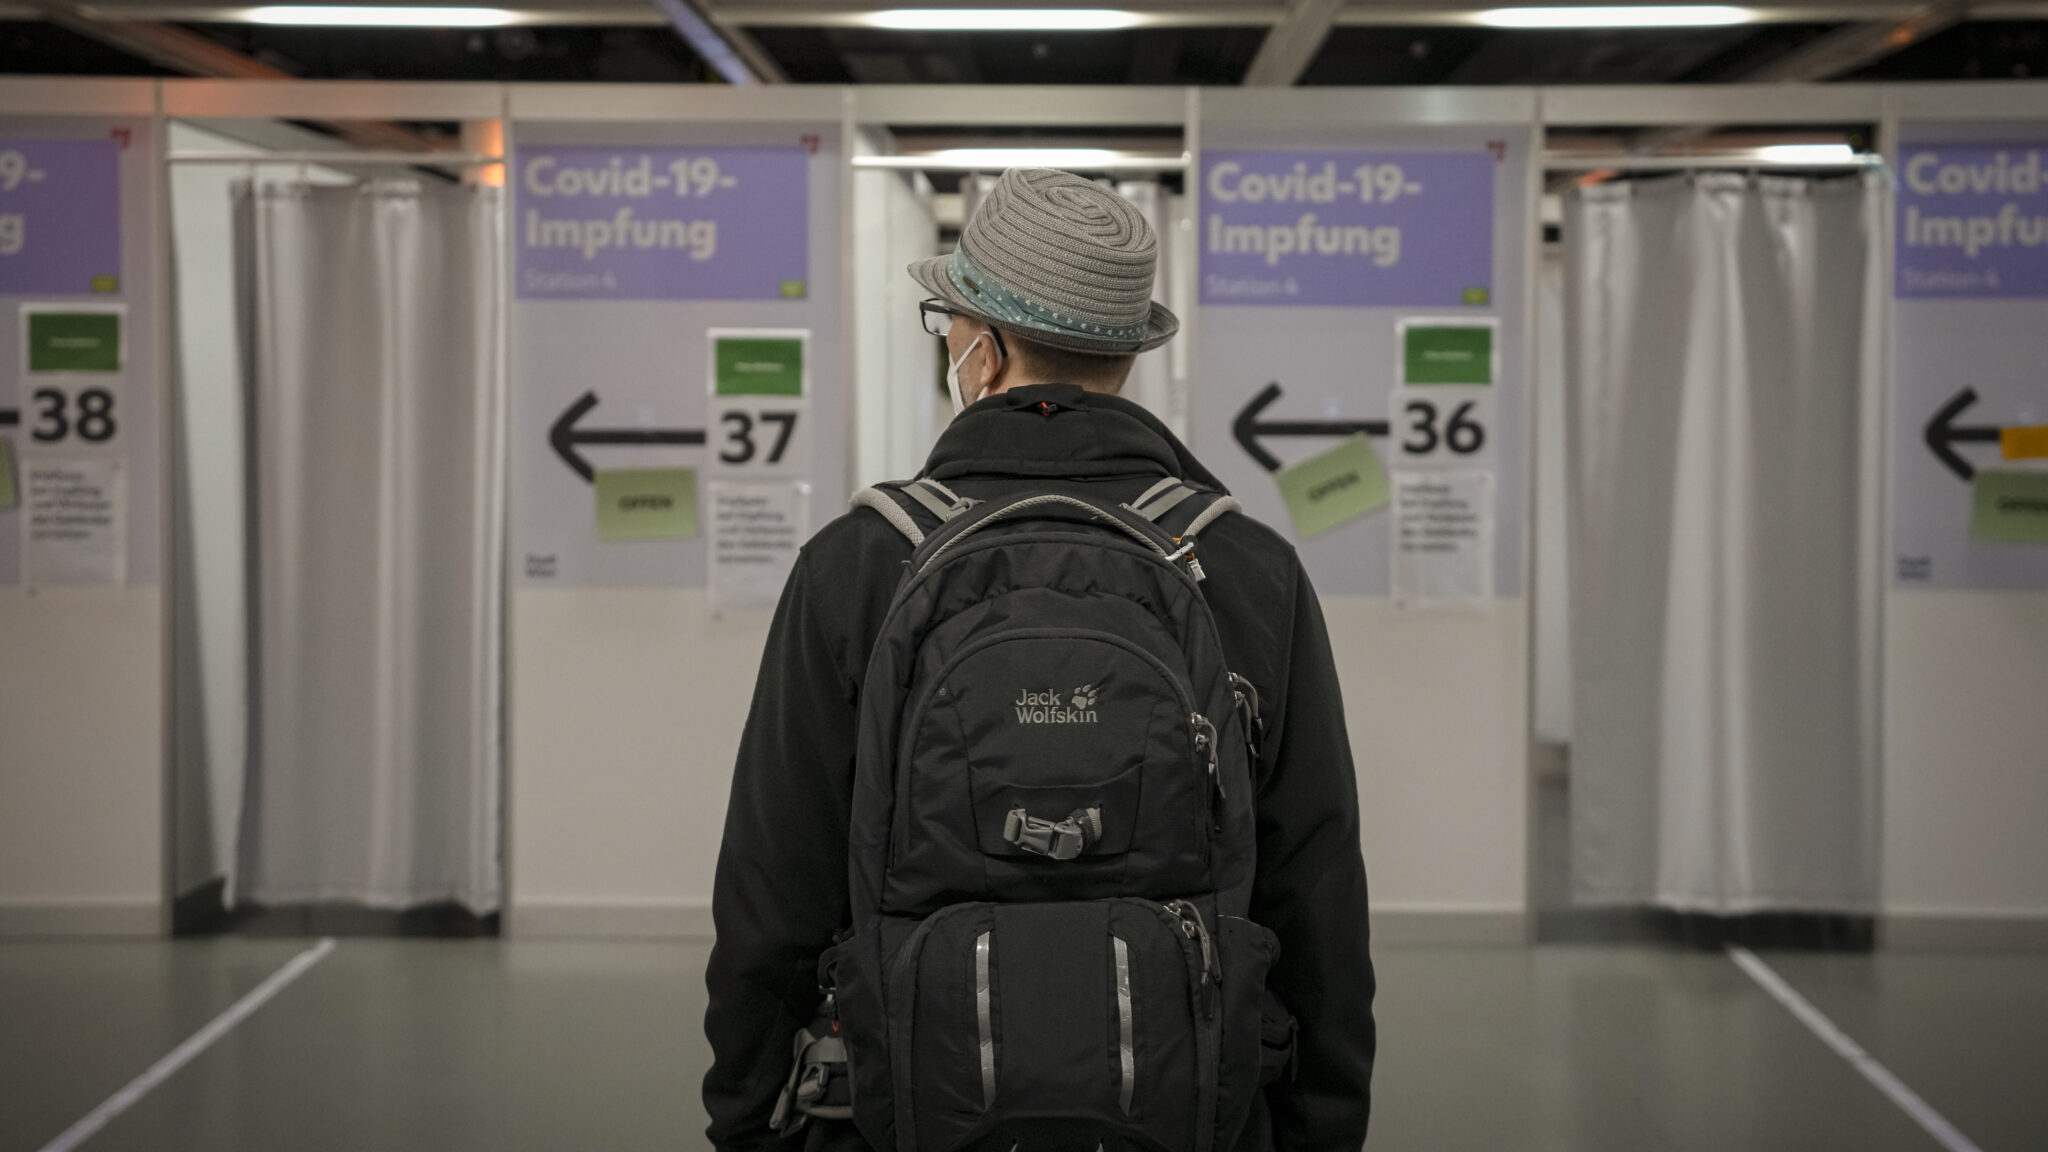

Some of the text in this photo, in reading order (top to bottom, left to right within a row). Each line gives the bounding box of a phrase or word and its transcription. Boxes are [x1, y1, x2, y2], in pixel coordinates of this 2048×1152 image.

[524, 155, 737, 197] Covid-19-
[1207, 161, 1423, 203] Covid-19-
[524, 208, 718, 261] Impfung
[1207, 215, 1402, 266] Impfung
[1906, 203, 2048, 259] Impfu
[523, 268, 599, 291] Station
[1203, 273, 1300, 298] Station 4
[29, 387, 118, 444] 38
[718, 410, 797, 465] 37
[1402, 401, 1486, 455] 36
[1015, 688, 1062, 706] Jack
[1015, 706, 1098, 724] Wolfskin
